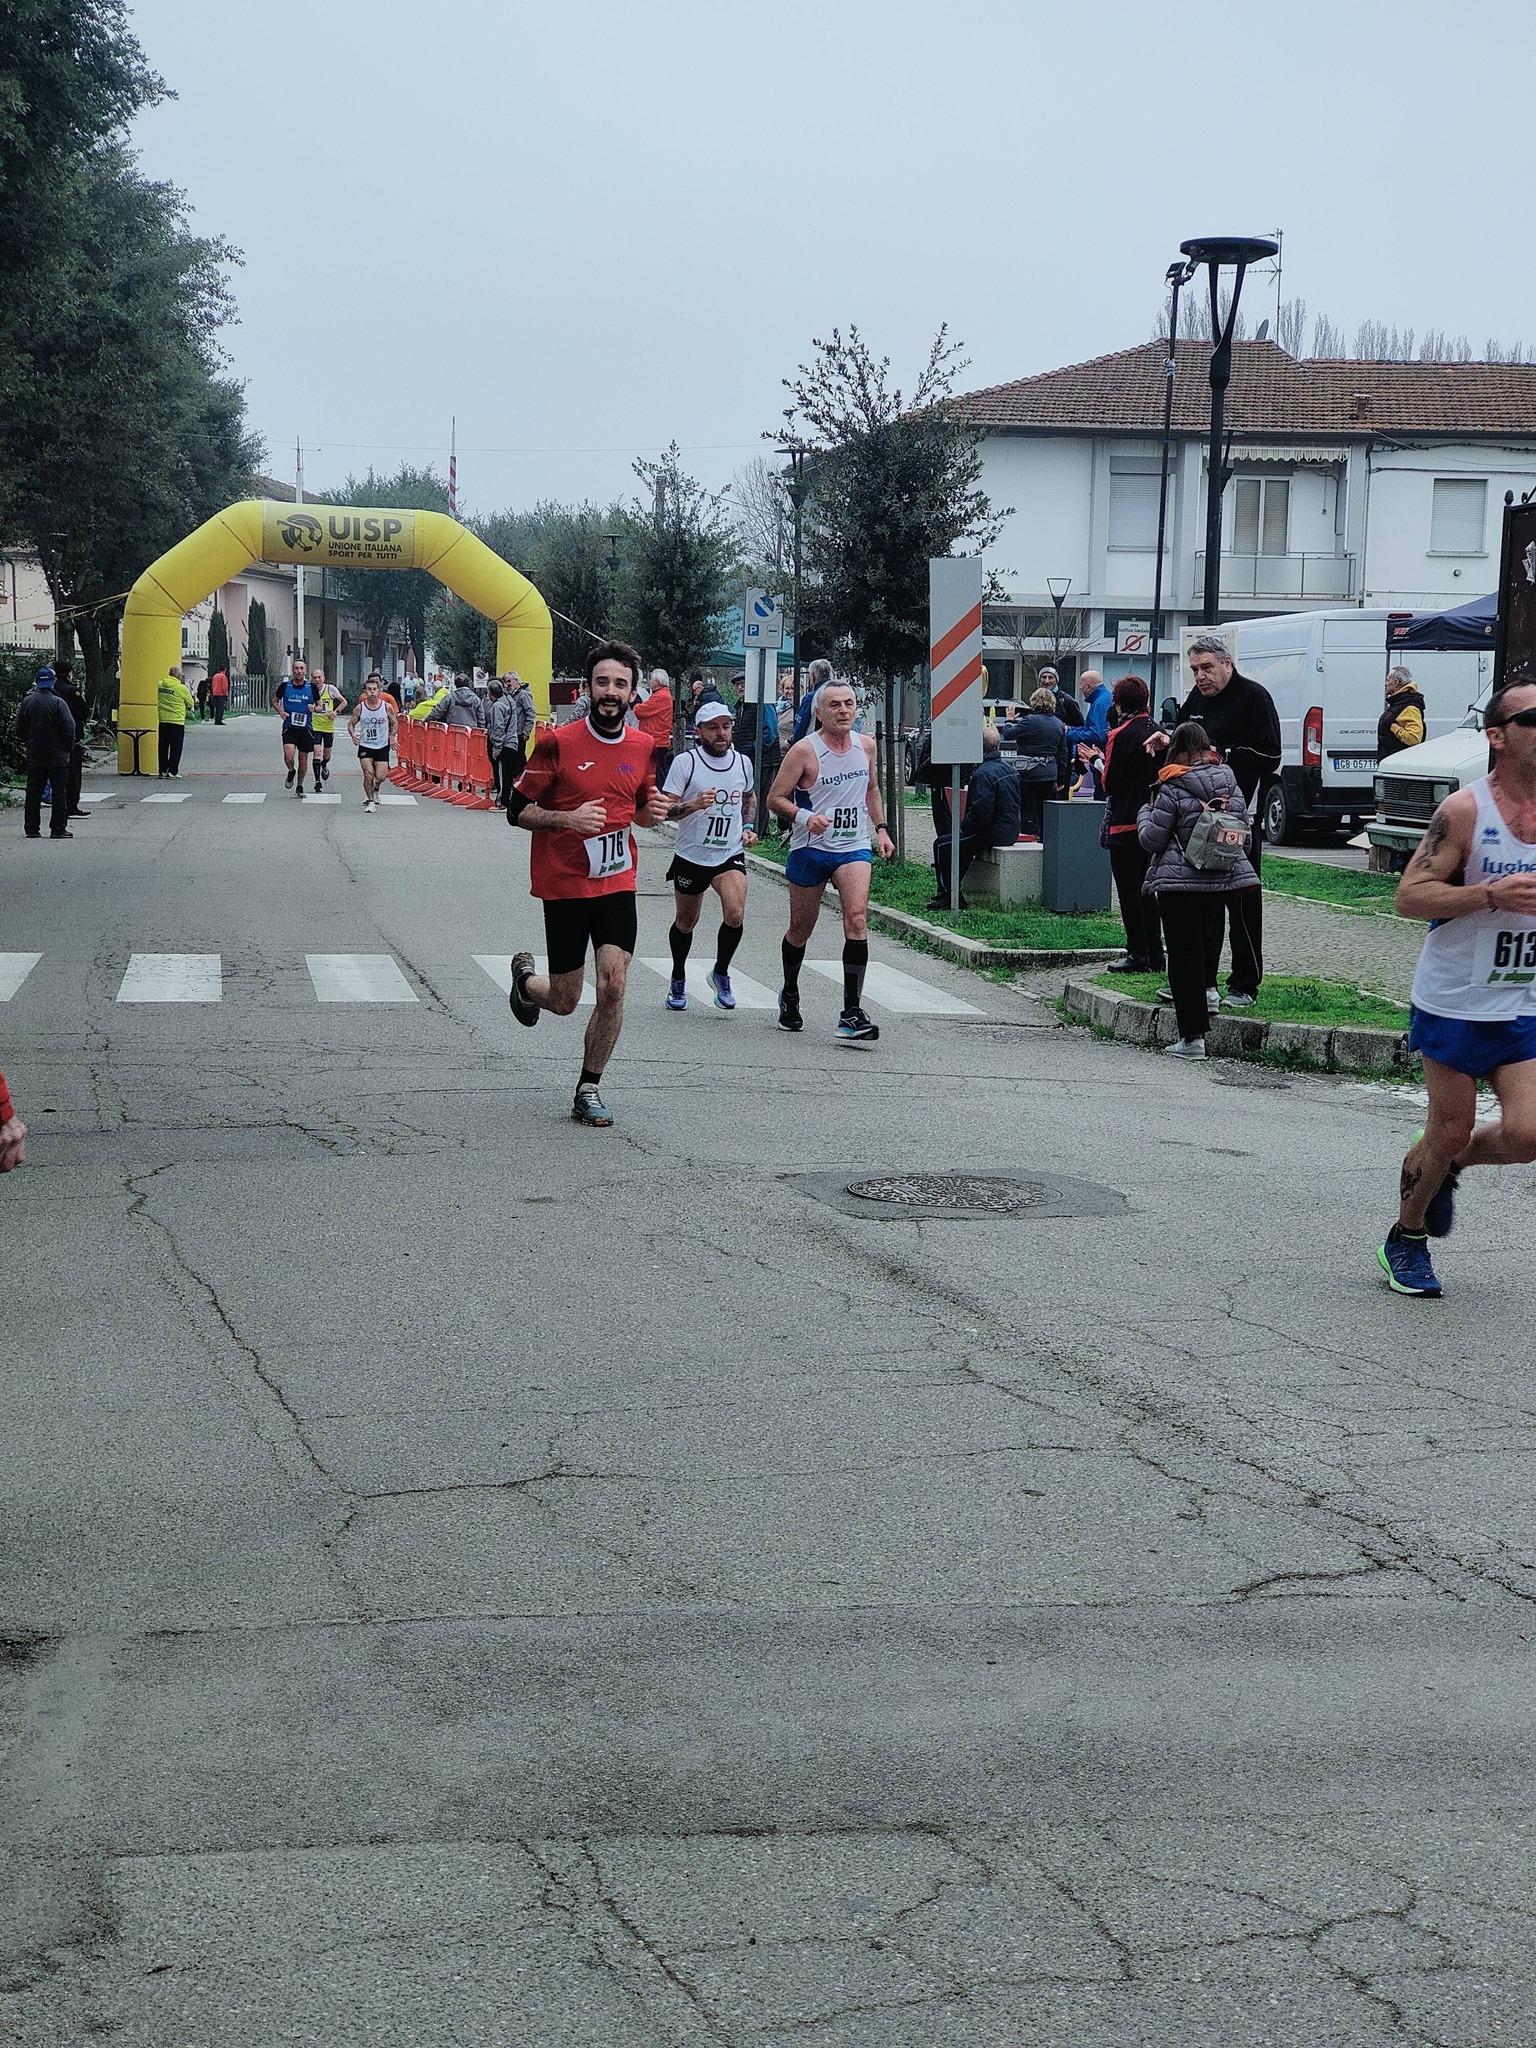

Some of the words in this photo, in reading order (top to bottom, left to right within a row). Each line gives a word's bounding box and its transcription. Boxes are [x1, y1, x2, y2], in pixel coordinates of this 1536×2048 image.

[328, 515, 403, 542] UISP
[328, 541, 361, 551] UNIONE
[364, 544, 403, 553] ITALIANA
[328, 550, 354, 558] SPORT
[357, 551, 372, 559] PER
[376, 552, 398, 560] TUTTI
[366, 729, 378, 738] 518
[706, 816, 732, 838] 707
[833, 807, 858, 829] 633
[597, 830, 625, 864] 776
[1493, 930, 1536, 968] 613
